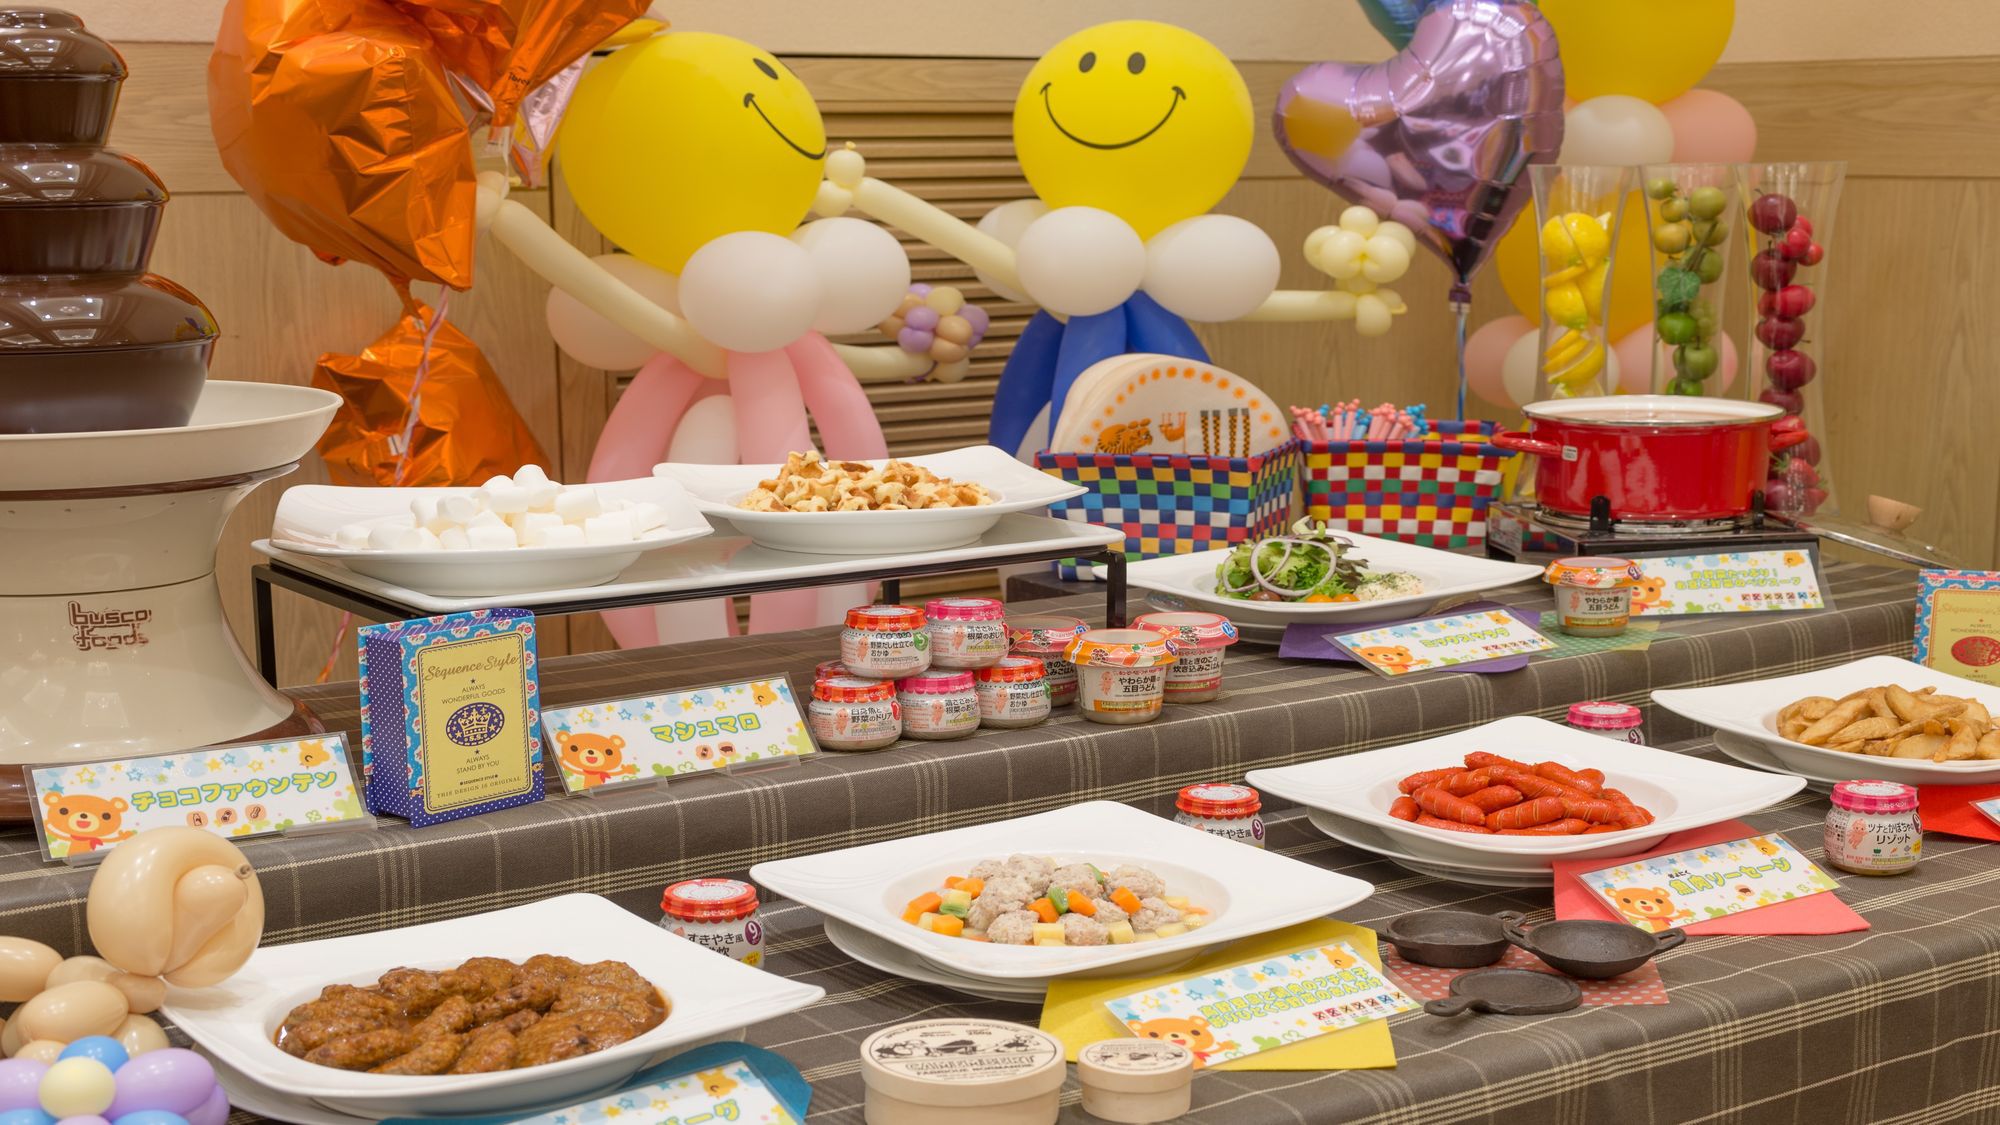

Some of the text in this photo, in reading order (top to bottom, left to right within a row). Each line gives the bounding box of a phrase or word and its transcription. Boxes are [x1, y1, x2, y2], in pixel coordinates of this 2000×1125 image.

[484, 653, 520, 671] Style
[462, 683, 486, 693] ALWAYS
[1122, 683, 1156, 693] 五目うどん
[441, 687, 506, 705] WONDERFUL GOODS
[650, 712, 762, 743] マシュマロ
[465, 754, 490, 764] ALWAYS
[456, 764, 476, 774] STAND
[487, 760, 500, 769] YOU
[131, 770, 337, 812] チョコファウンテン
[1876, 834, 1911, 845] リゾット
[1669, 857, 1792, 896] 魚肉ソーセージ
[688, 932, 744, 946] すきやき風
